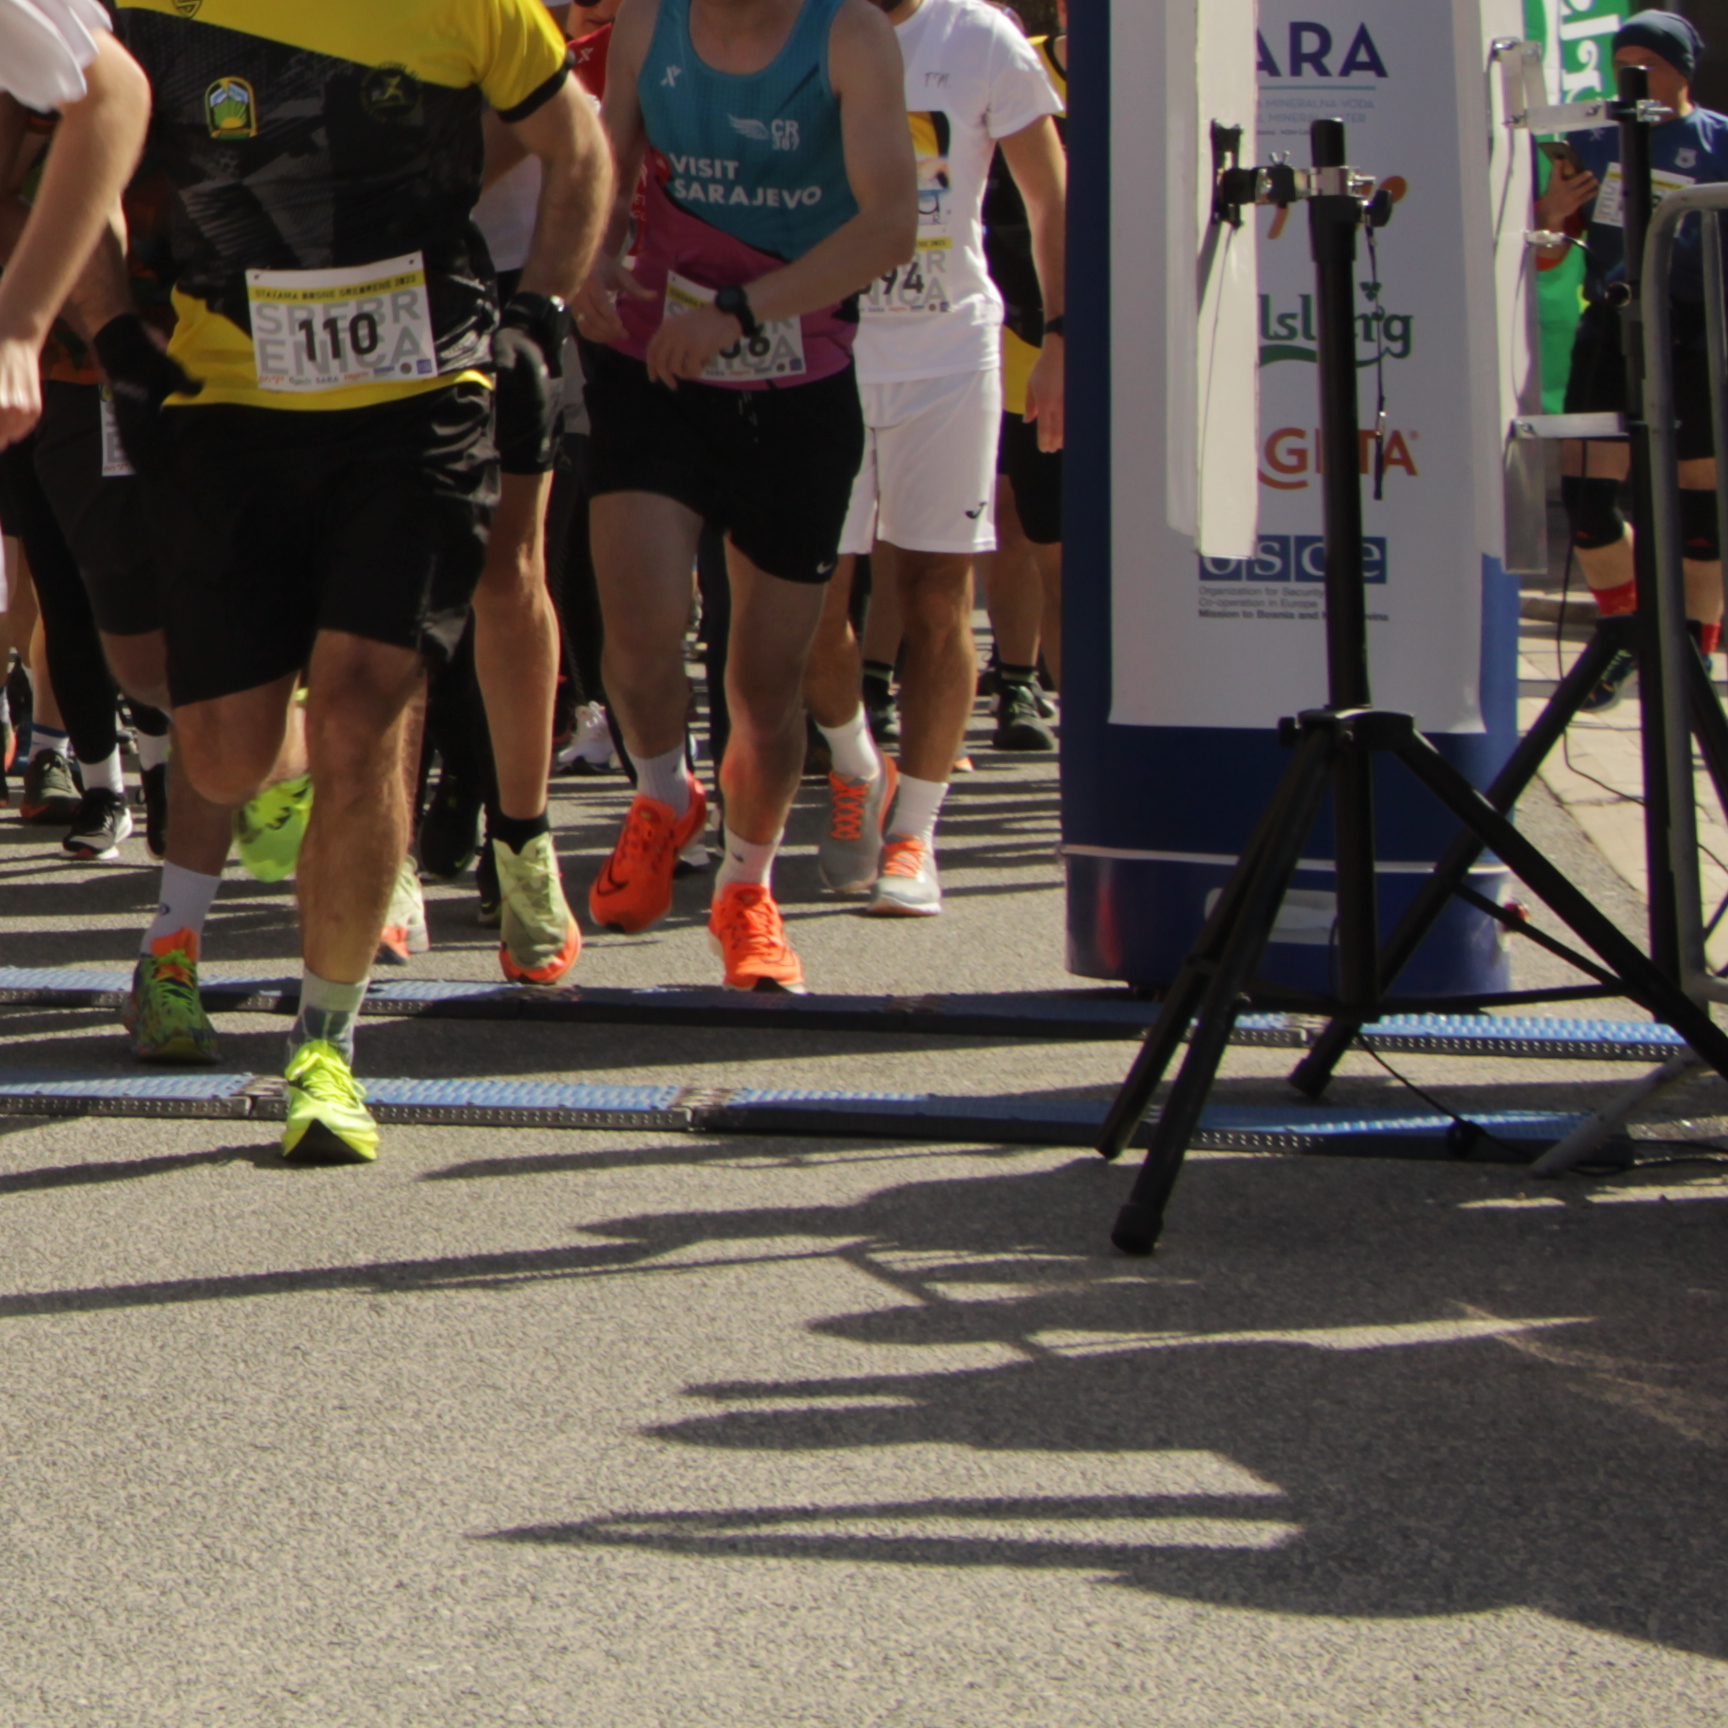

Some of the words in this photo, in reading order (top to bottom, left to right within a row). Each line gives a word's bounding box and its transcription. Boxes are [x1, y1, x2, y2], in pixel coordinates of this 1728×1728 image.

[669, 153, 739, 180] VISIT
[674, 178, 822, 209] SARAJEVO
[298, 312, 378, 362] 110
